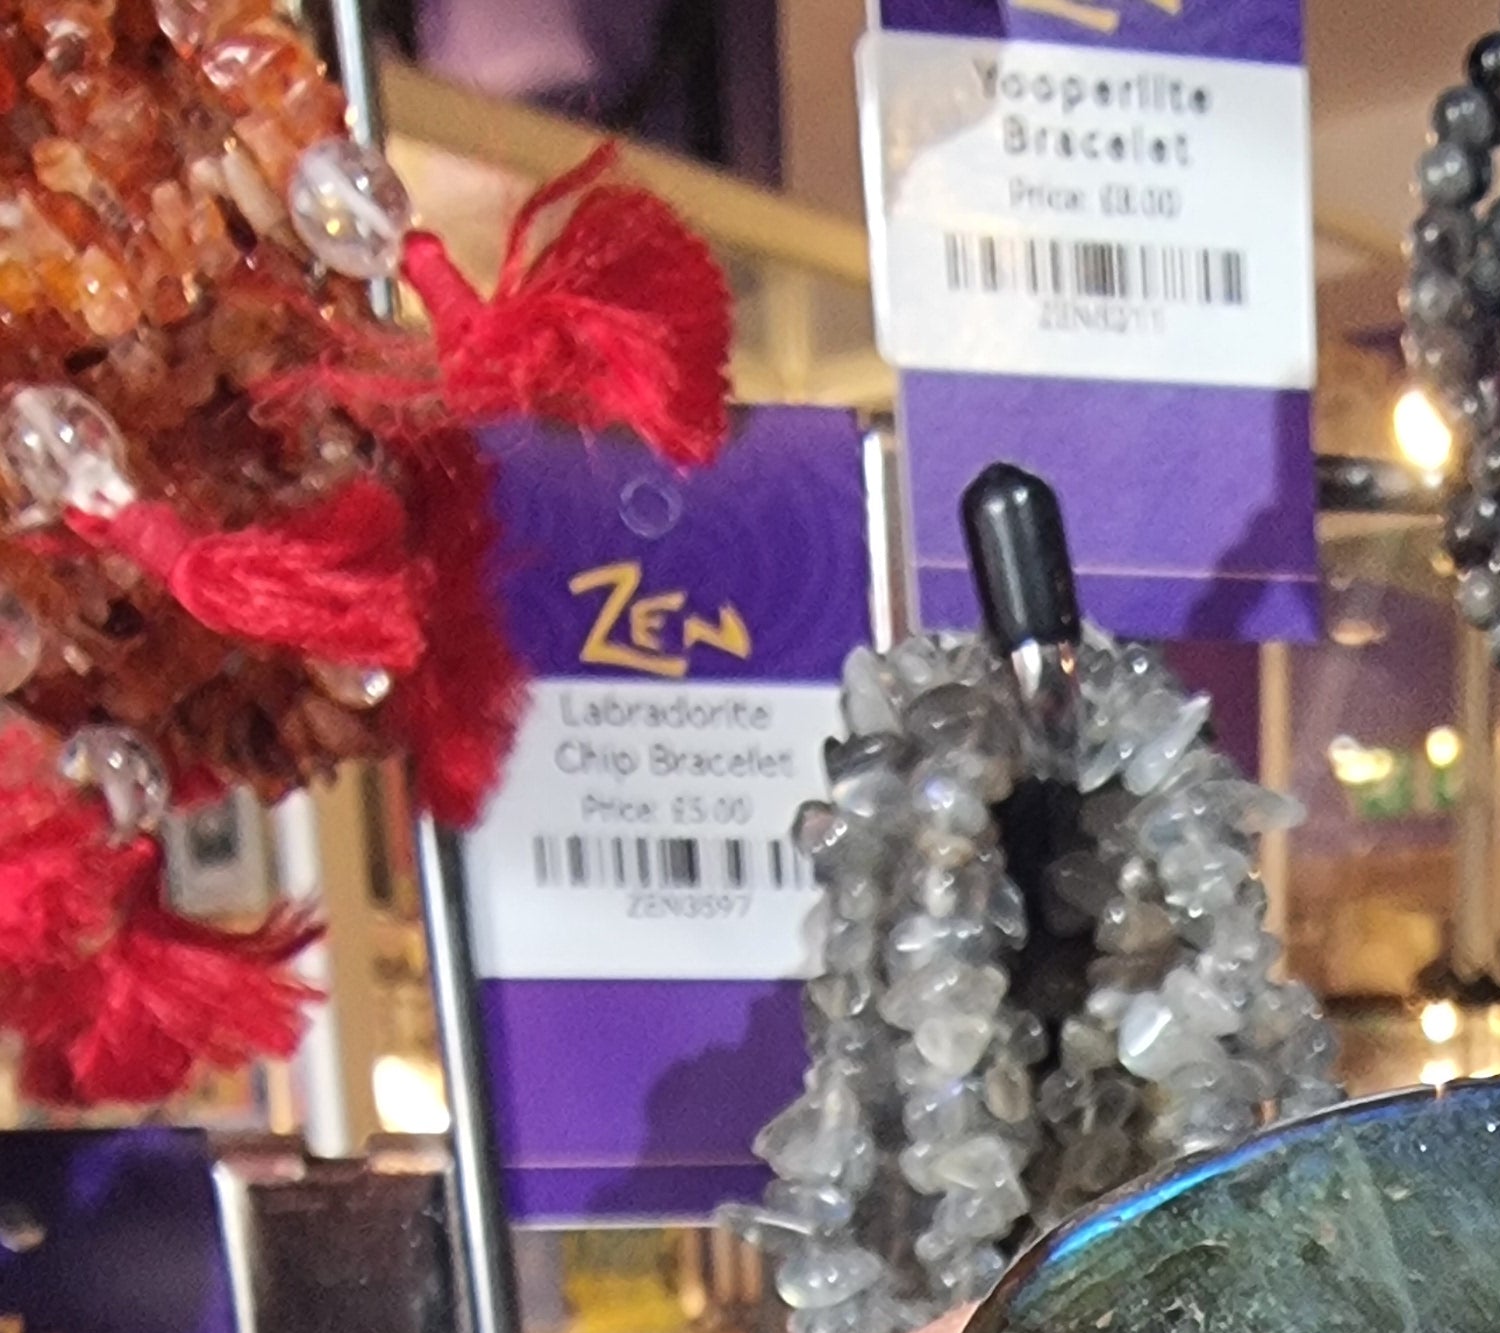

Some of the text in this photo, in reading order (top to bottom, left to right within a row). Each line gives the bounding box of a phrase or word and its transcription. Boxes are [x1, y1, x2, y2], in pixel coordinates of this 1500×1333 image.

[970, 57, 1212, 113] Yooperlite
[1003, 113, 1191, 168] Bracelet
[1008, 176, 1086, 213] Price:
[568, 561, 752, 678] ZEN
[560, 693, 773, 731] Labradorite
[554, 741, 796, 784] Chip Bracelet
[581, 794, 753, 826] Price: £5.00
